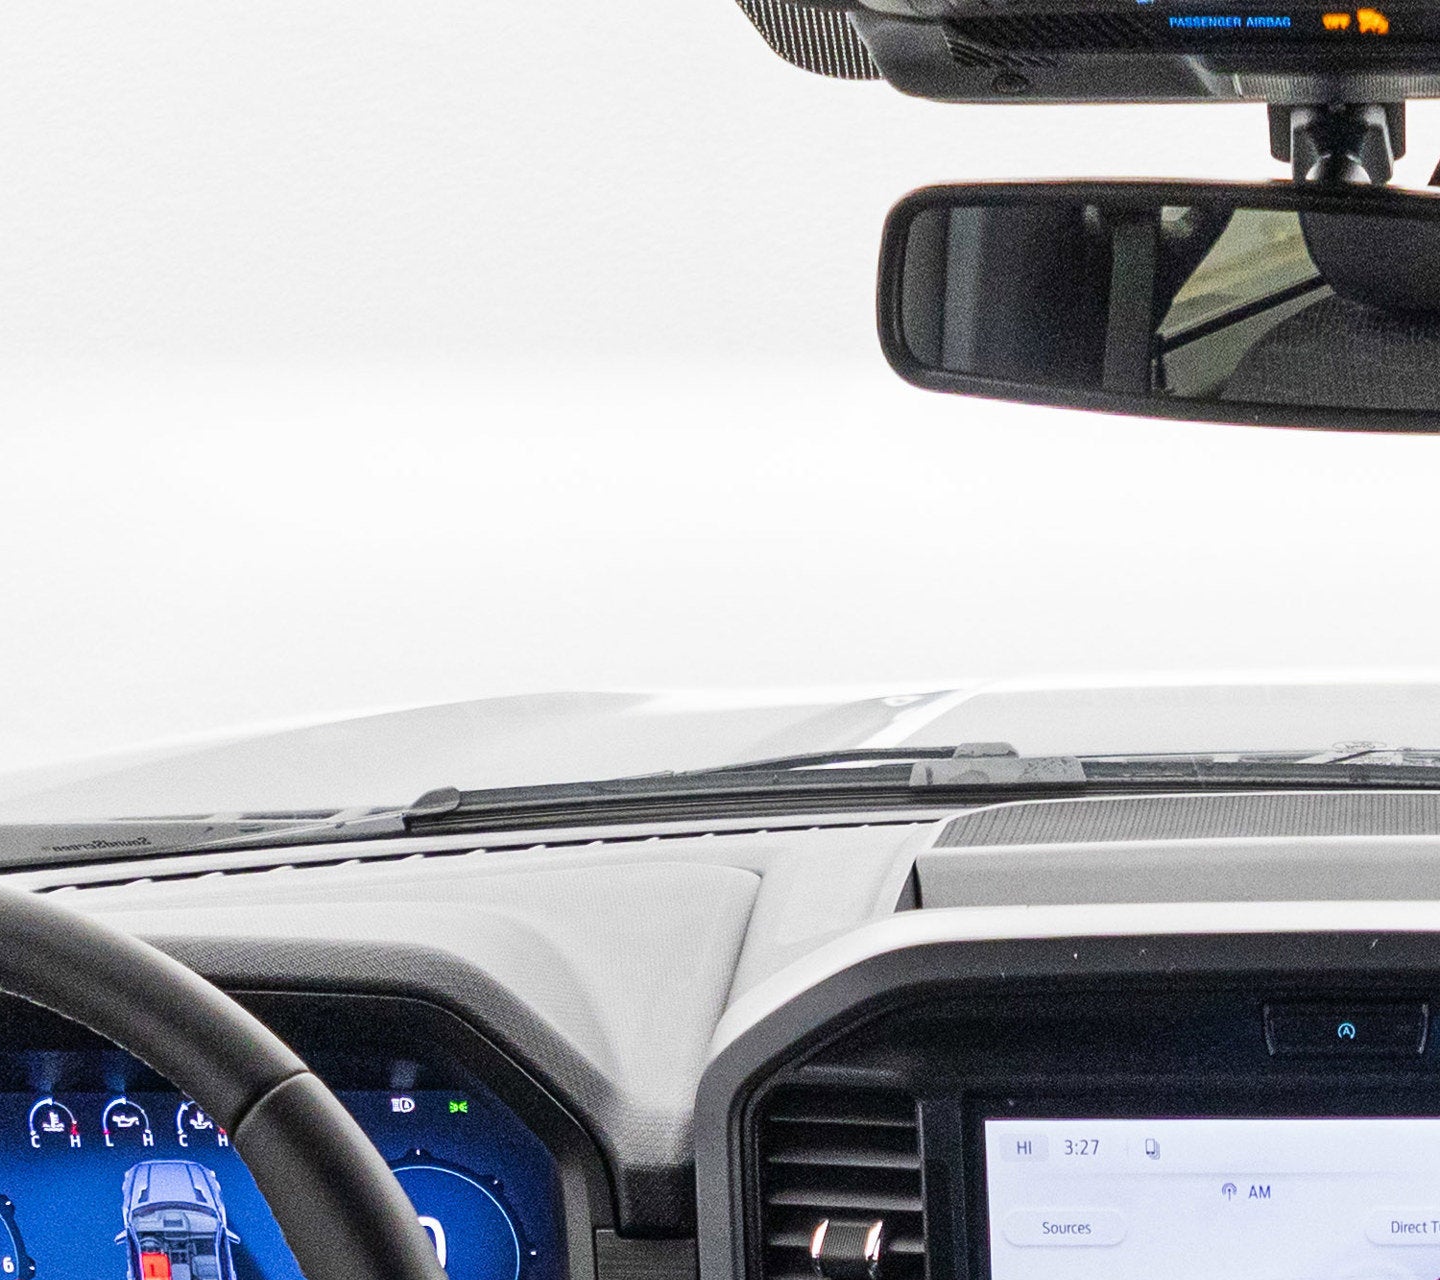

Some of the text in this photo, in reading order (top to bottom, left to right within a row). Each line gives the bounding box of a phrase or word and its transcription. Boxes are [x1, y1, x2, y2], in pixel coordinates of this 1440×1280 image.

[1168, 16, 1291, 28] PASSENGER AIRBAG
[31, 1135, 40, 1148] C
[70, 1135, 81, 1148] H
[105, 1134, 114, 1147] L
[142, 1134, 154, 1147] H
[178, 1134, 188, 1147] C
[218, 1134, 228, 1147] H
[1016, 1141, 1033, 1155] HI
[1063, 1139, 1100, 1156] 3:27
[1248, 1185, 1271, 1199] AM
[1042, 1221, 1092, 1235] Sources
[1390, 1221, 1427, 1234] Direct
[2, 1256, 15, 1274] 6
